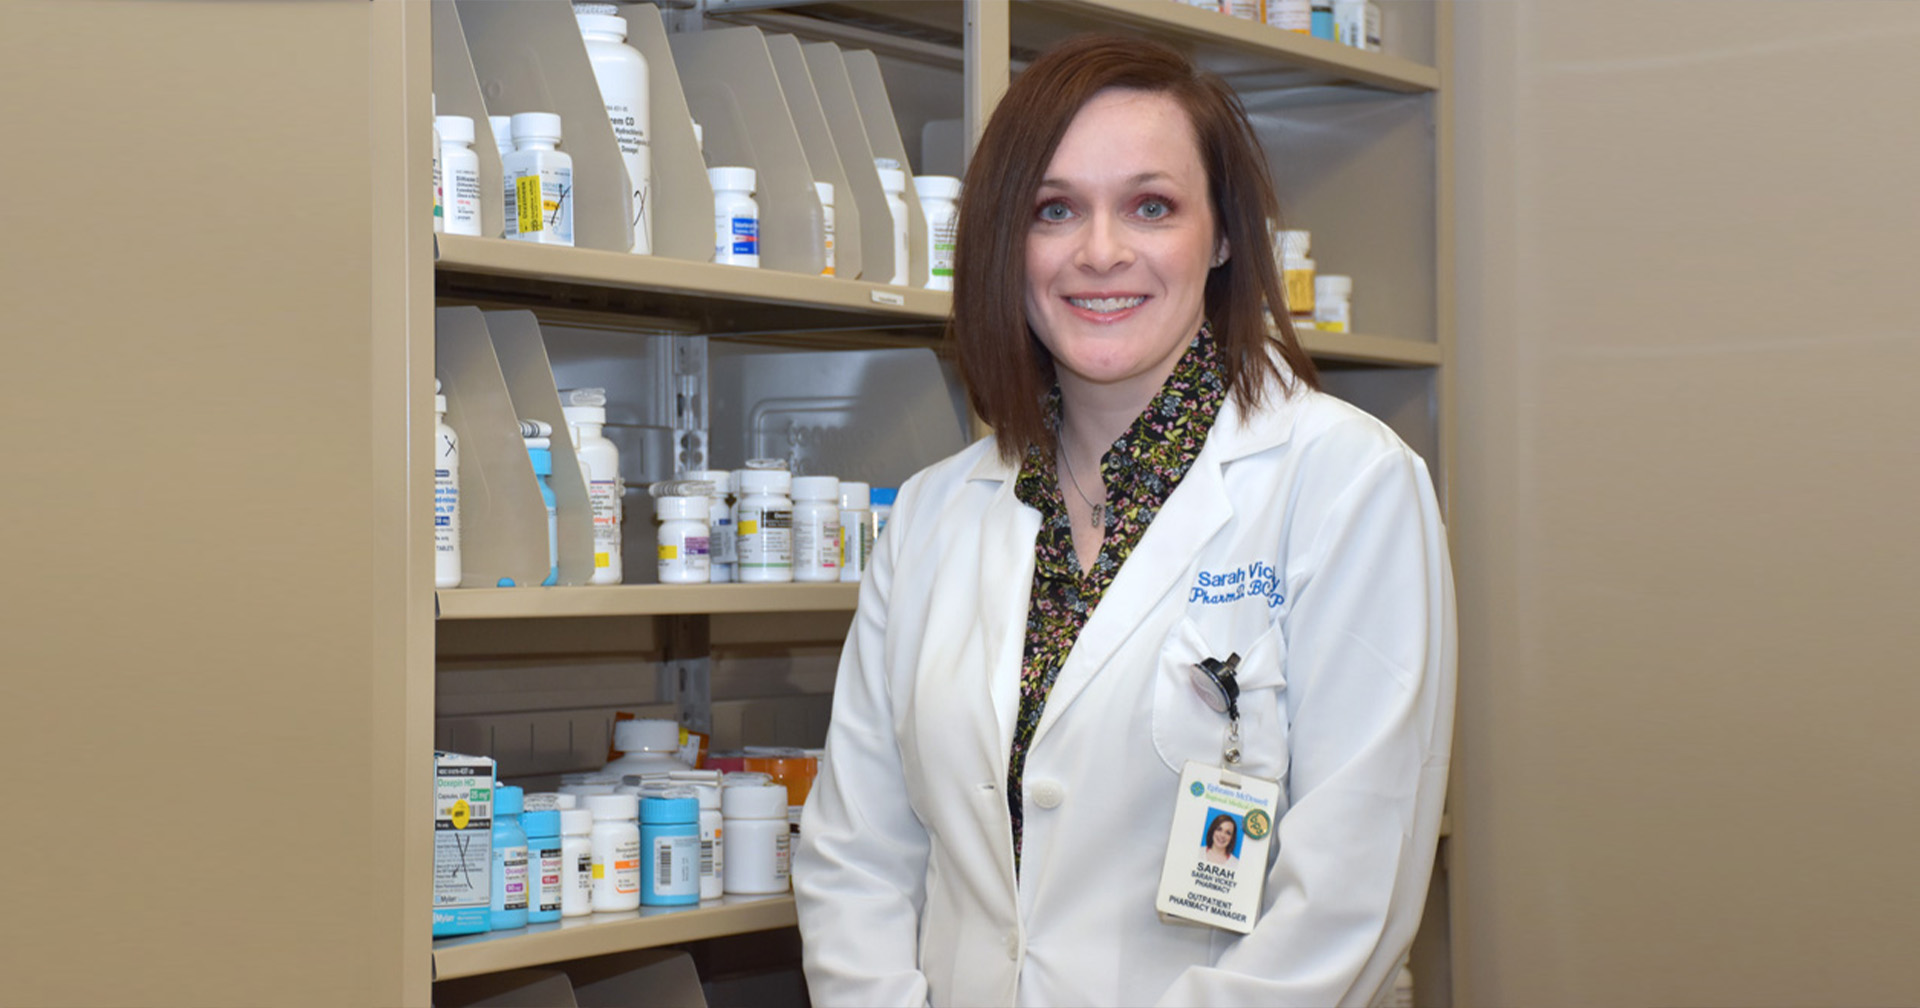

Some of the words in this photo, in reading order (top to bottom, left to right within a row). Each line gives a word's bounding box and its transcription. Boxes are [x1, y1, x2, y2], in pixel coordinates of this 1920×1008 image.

[1198, 567, 1245, 587] Sarah
[1191, 870, 1213, 881] SARAH
[1215, 877, 1237, 888] VICKEY
[1197, 862, 1235, 879] SARAH
[1195, 879, 1230, 894] PHARMACY
[1169, 895, 1209, 912] PHARMACY
[1210, 907, 1247, 922] MANAGER
[1187, 891, 1232, 910] OUTPATIENT
